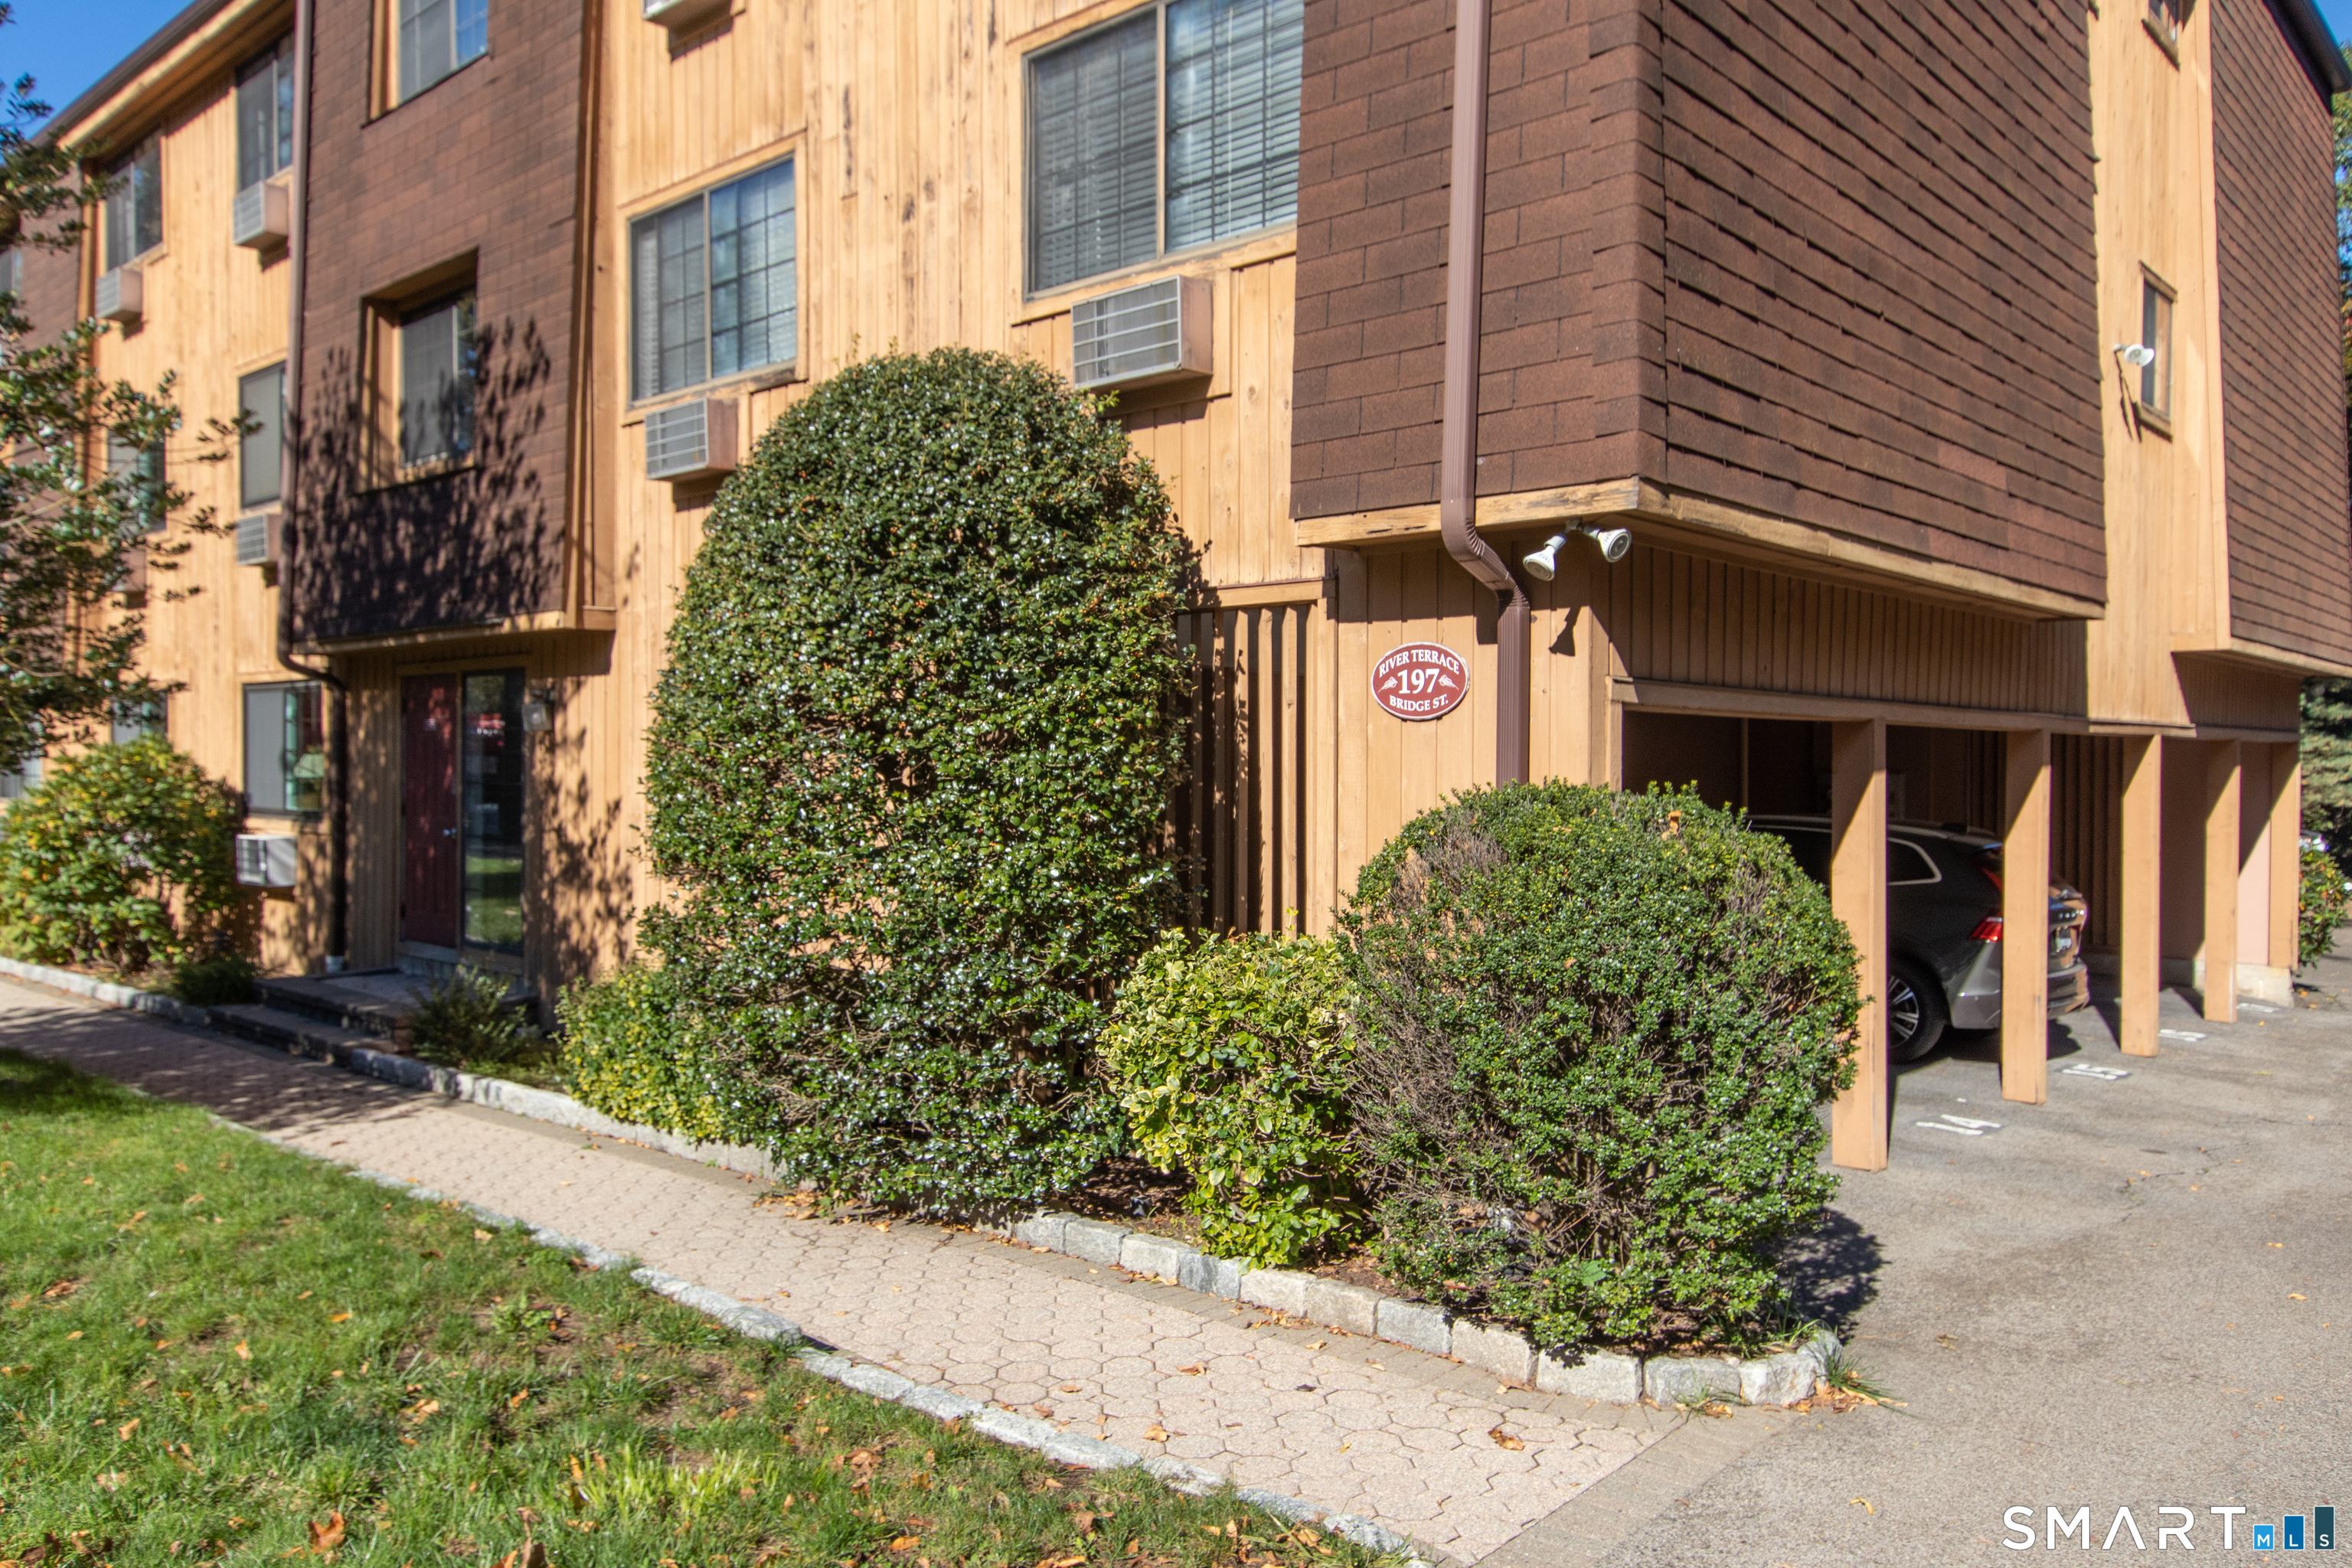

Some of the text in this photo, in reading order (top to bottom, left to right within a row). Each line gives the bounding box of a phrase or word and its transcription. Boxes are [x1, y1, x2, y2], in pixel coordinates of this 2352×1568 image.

[1379, 649, 1460, 678] RIVER TERRACE
[1397, 668, 1440, 694] 197
[1390, 694, 1449, 712] BRIDGE ST.
[1916, 1114, 2001, 1136] 14
